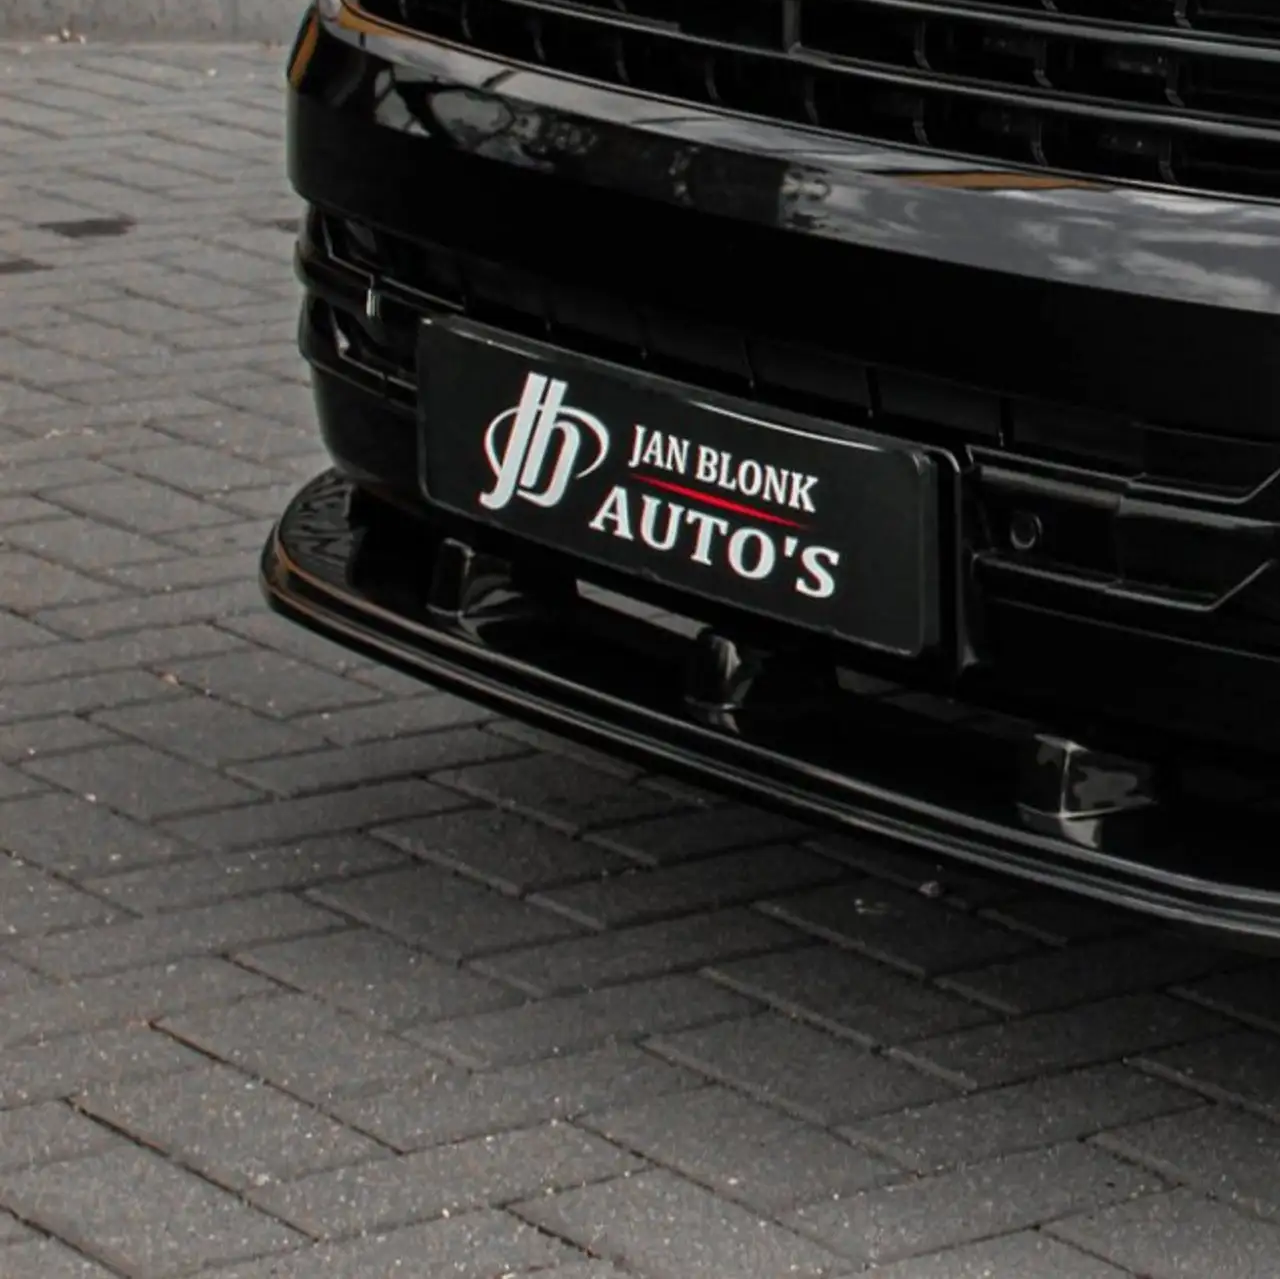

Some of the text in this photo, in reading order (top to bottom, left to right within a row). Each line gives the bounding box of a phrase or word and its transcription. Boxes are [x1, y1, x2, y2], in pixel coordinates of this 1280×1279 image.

[628, 424, 819, 513] JAN BLONK
[588, 485, 840, 599] AUTO'S
